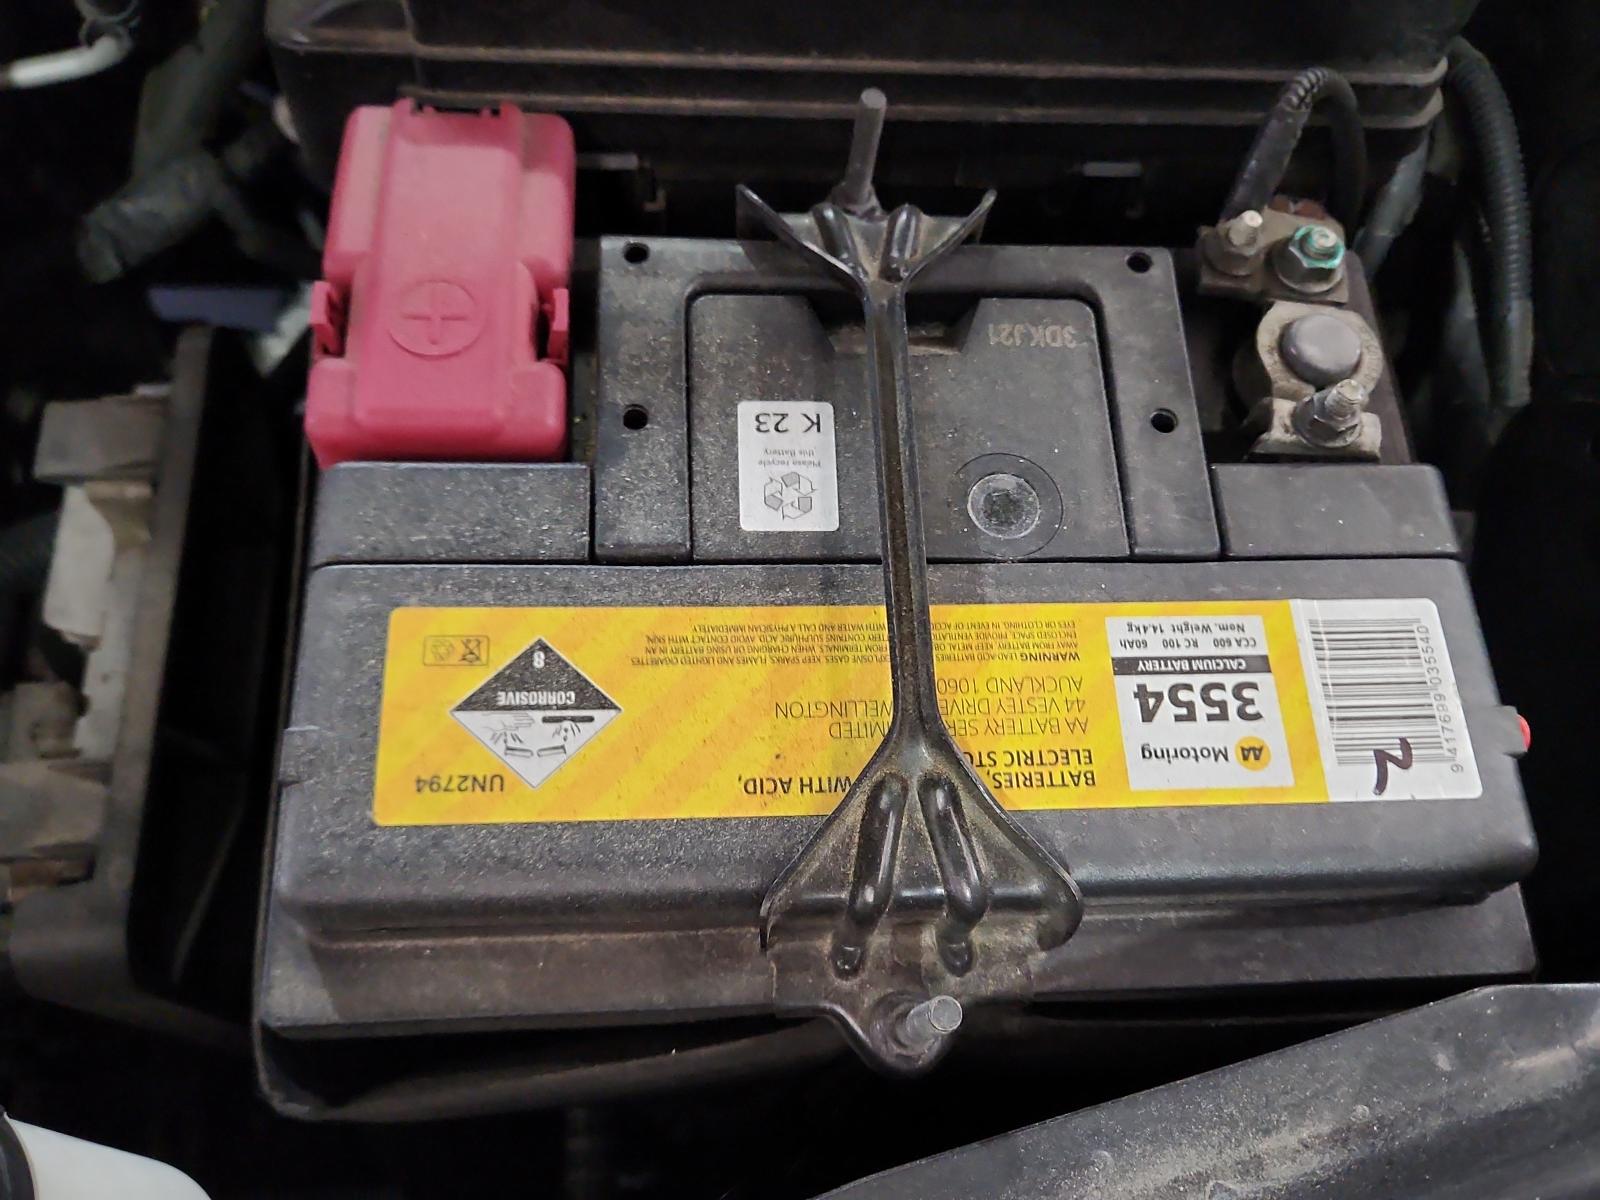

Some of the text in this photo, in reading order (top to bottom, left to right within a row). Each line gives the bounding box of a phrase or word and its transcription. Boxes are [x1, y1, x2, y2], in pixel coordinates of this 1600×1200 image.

[754, 413, 821, 433] K 23
[763, 448, 796, 457] Battery
[758, 456, 821, 468] Please recycle
[789, 624, 796, 632] A
[799, 624, 816, 632] CALL
[819, 624, 835, 632] AND
[838, 623, 864, 631] WATER
[865, 623, 886, 631] WITH
[966, 622, 990, 630] EVENT
[1057, 620, 1075, 628] EYES
[1171, 623, 1211, 634] Weight
[1214, 622, 1245, 633] Nom.
[747, 625, 788, 633] PHYSICIAN
[691, 635, 728, 644] CONTACT
[731, 635, 755, 644] AVOID
[780, 634, 823, 643] SULPHURIC
[826, 633, 865, 642] CONTAINS
[976, 633, 1008, 641] PROVIDE
[1037, 631, 1077, 639] ENCLOSED
[668, 636, 689, 644] WITH
[1119, 637, 1256, 650] CCA 600 RC 100 60Ah
[645, 647, 657, 655] AN
[659, 647, 667, 655] IN
[670, 646, 704, 655] BATTERY
[706, 646, 731, 654] USING
[733, 646, 744, 654] OR
[745, 645, 789, 654] CHARGING
[791, 645, 816, 654] WHEN
[864, 644, 888, 652] FROM
[949, 643, 972, 651] METAL
[532, 651, 546, 669] 8
[680, 657, 714, 665] LIGHTED
[716, 657, 734, 665] AND
[736, 656, 766, 665] FLAMES
[802, 655, 821, 664] KEEP
[1020, 652, 1080, 661] WARNING
[1137, 658, 1246, 672] CALCIUM BATTERY
[937, 675, 1082, 695] AUCKLAND 1060
[495, 690, 577, 706] CORROSIVE
[1133, 681, 1264, 723] 3554
[939, 697, 991, 716] DRIVE
[996, 697, 1060, 714] VESTEY
[1065, 697, 1085, 713] 44
[984, 717, 1060, 736] BATTERY
[1065, 717, 1088, 735] AA
[1003, 749, 1093, 766] ELECTRIC
[1140, 743, 1264, 764] AA Motoring
[414, 774, 505, 793] UN2794
[737, 770, 1096, 795] BATTERIES, WITH ACID,
